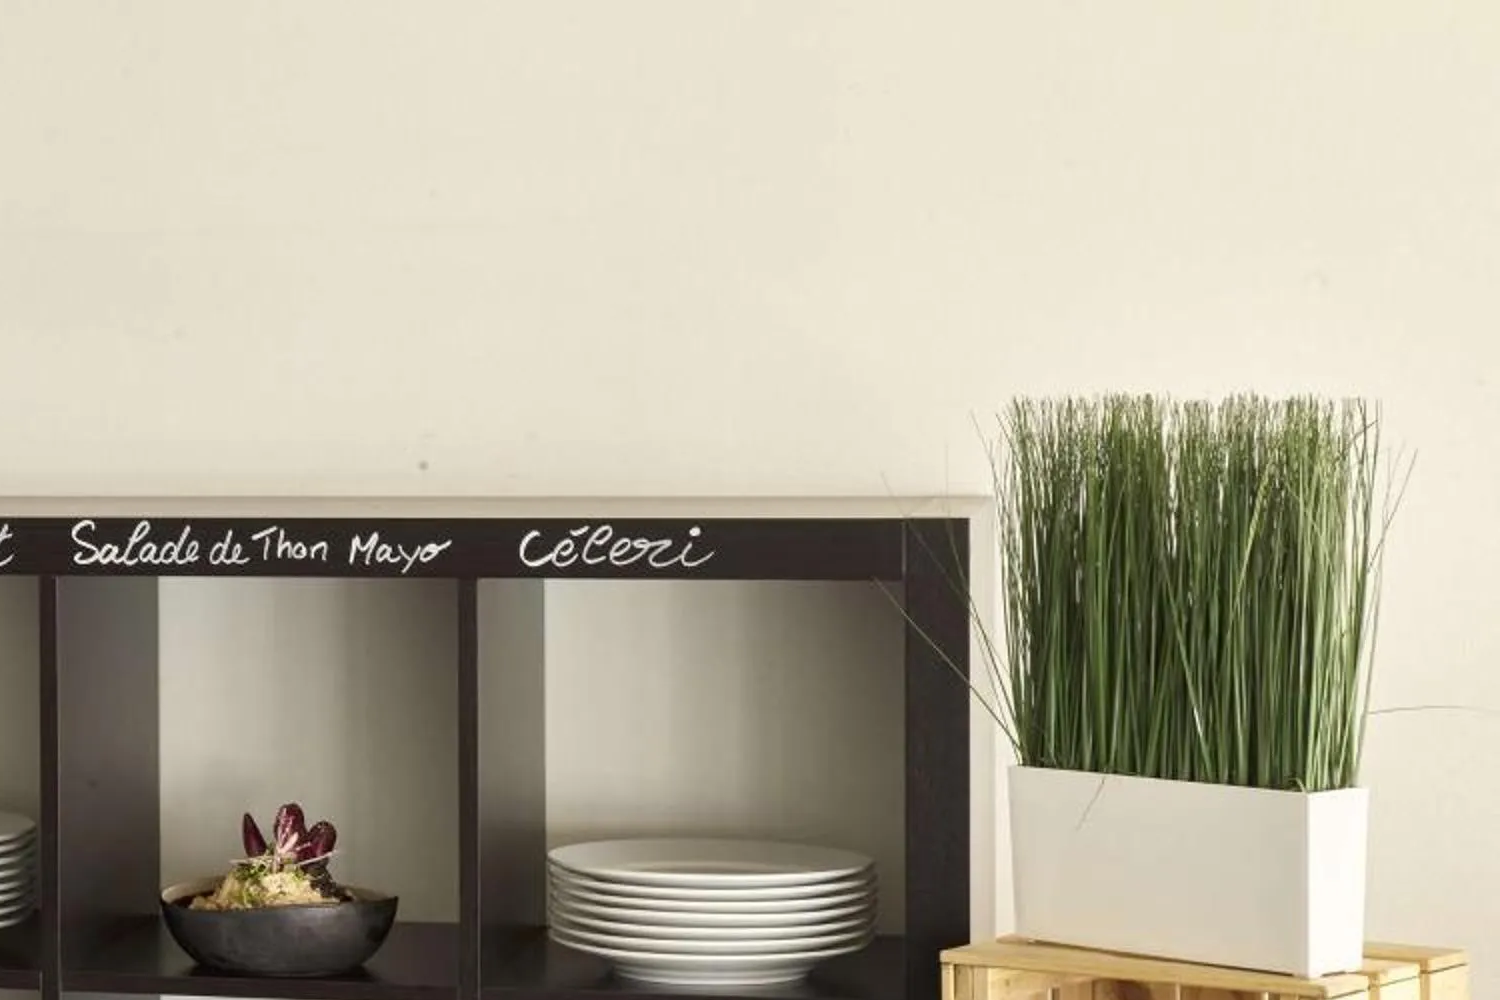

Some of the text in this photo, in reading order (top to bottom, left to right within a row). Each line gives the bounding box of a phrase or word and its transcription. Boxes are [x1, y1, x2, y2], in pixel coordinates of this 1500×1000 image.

[70, 519, 453, 574] Salade de Thon Mayo
[518, 524, 716, 568] Céleri
